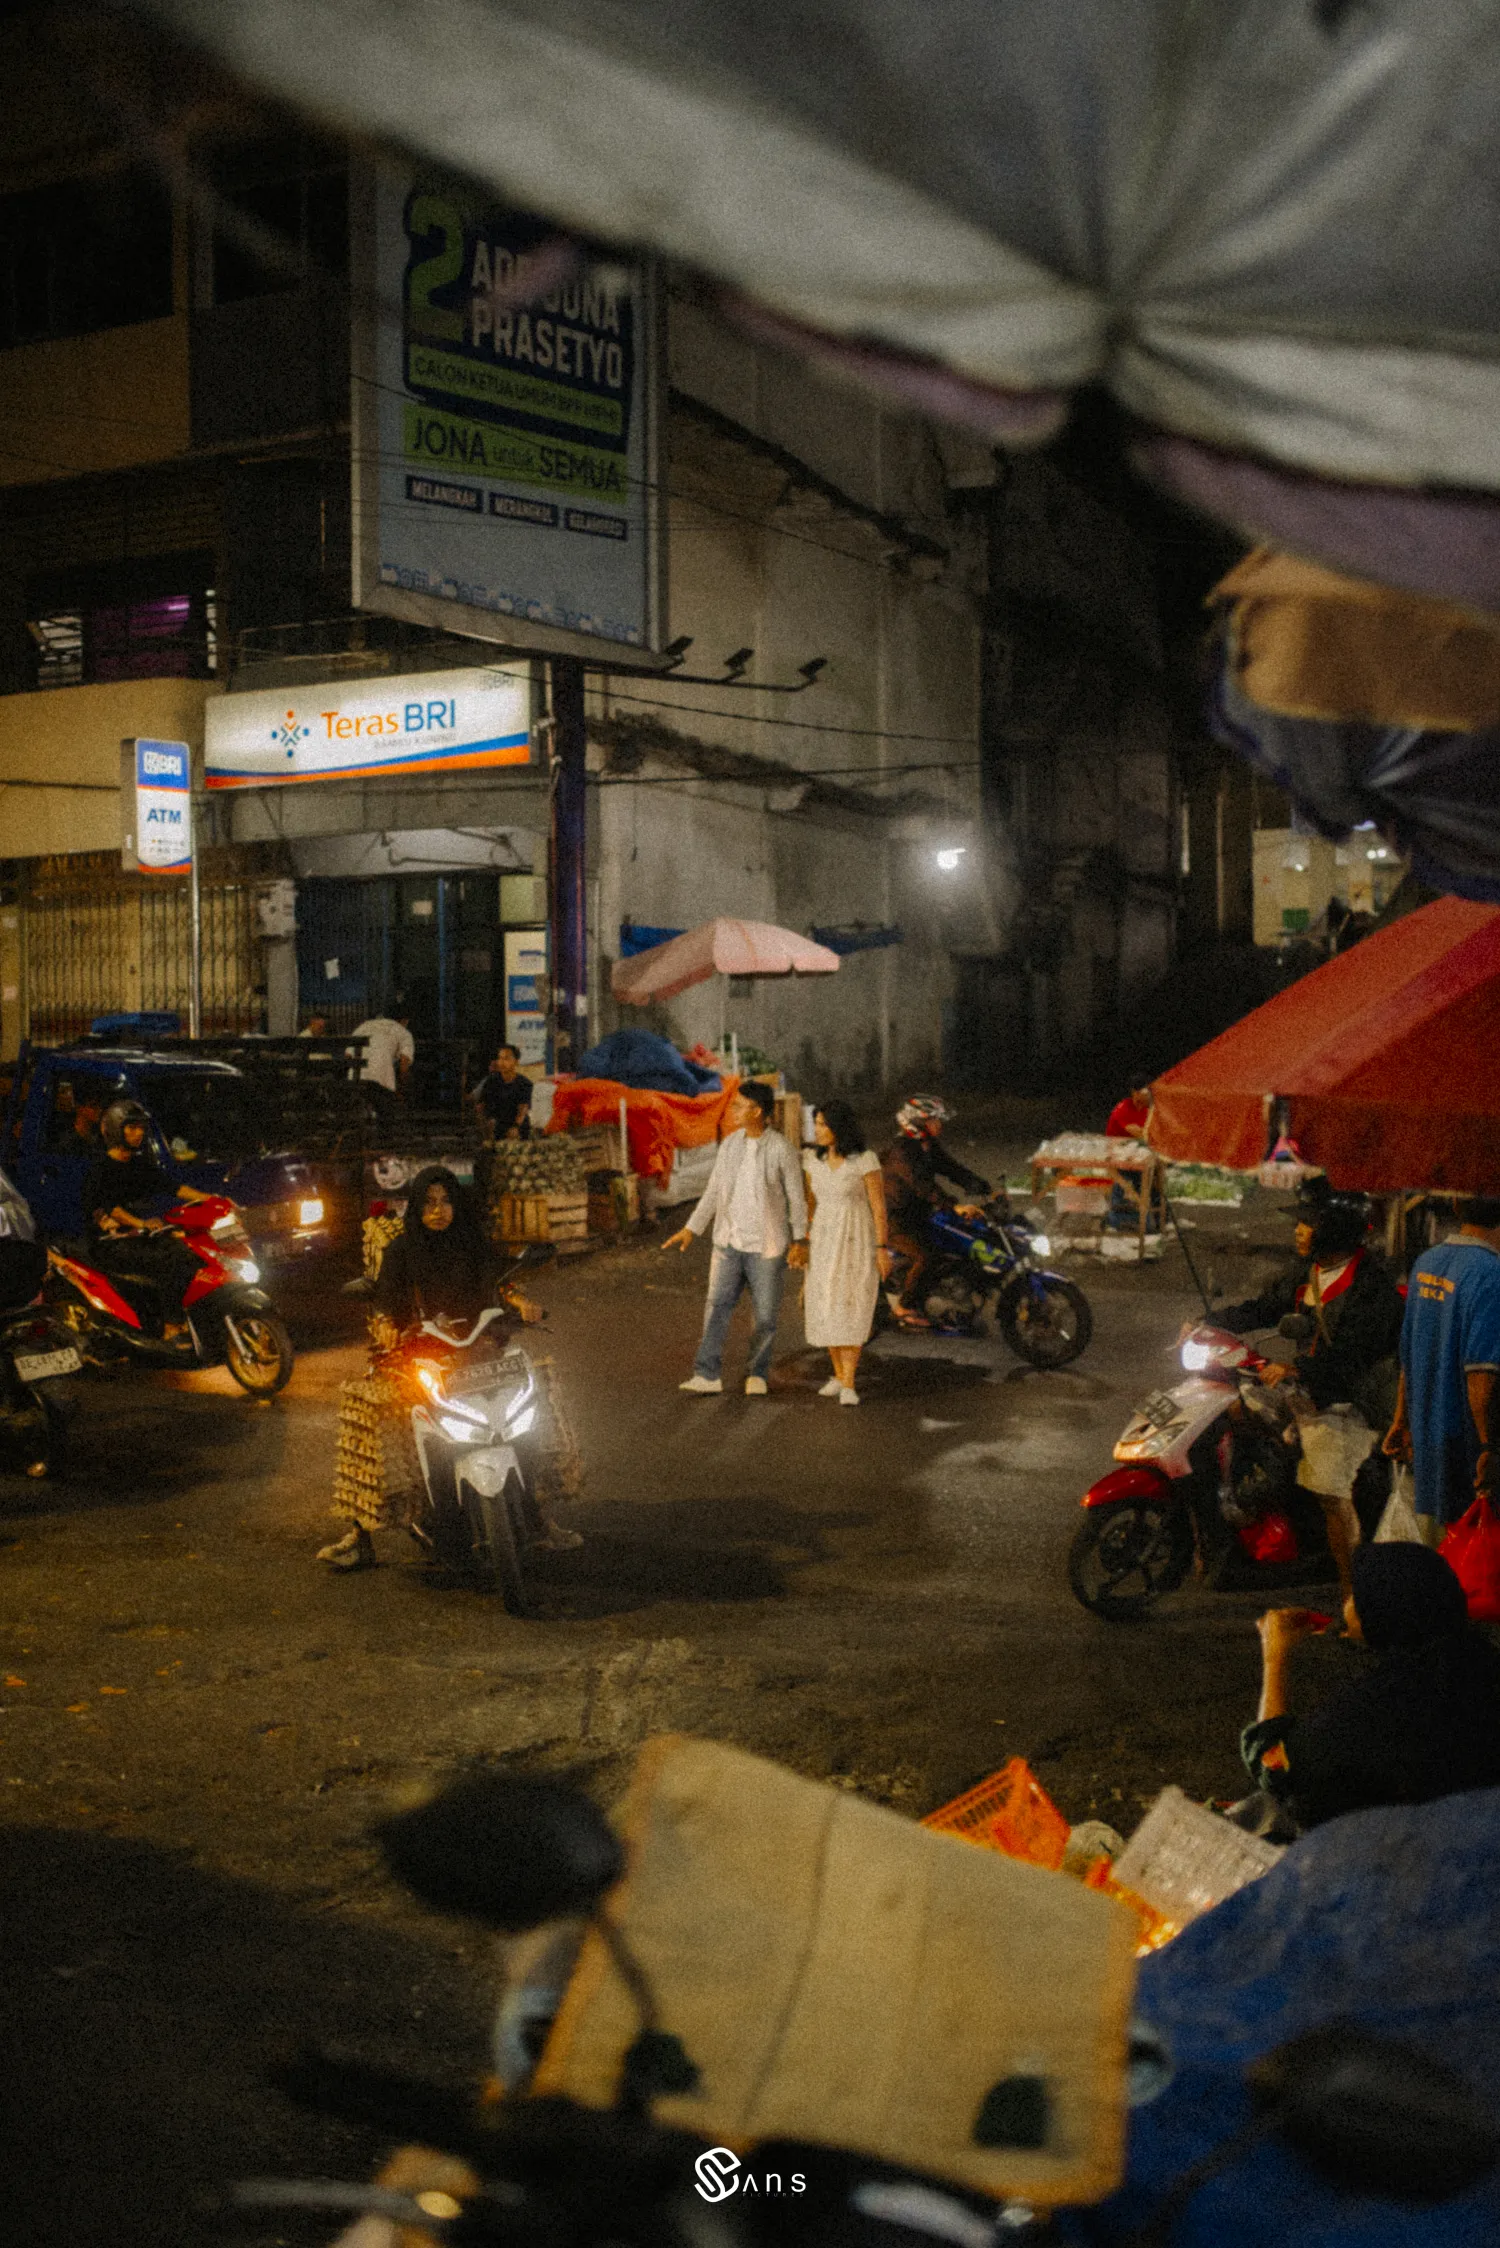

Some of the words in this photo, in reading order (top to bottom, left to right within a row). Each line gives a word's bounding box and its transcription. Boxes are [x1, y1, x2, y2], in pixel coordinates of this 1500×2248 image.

[410, 196, 464, 343] 2
[471, 298, 624, 389] PRASETYO
[414, 354, 464, 385] CALON
[466, 367, 508, 397] KETUA
[413, 418, 488, 466] JONA
[493, 445, 535, 466] untuk
[540, 446, 621, 492] SEMUA
[321, 709, 399, 741] Teras
[404, 699, 456, 732] BRI
[147, 808, 182, 824] ATM
